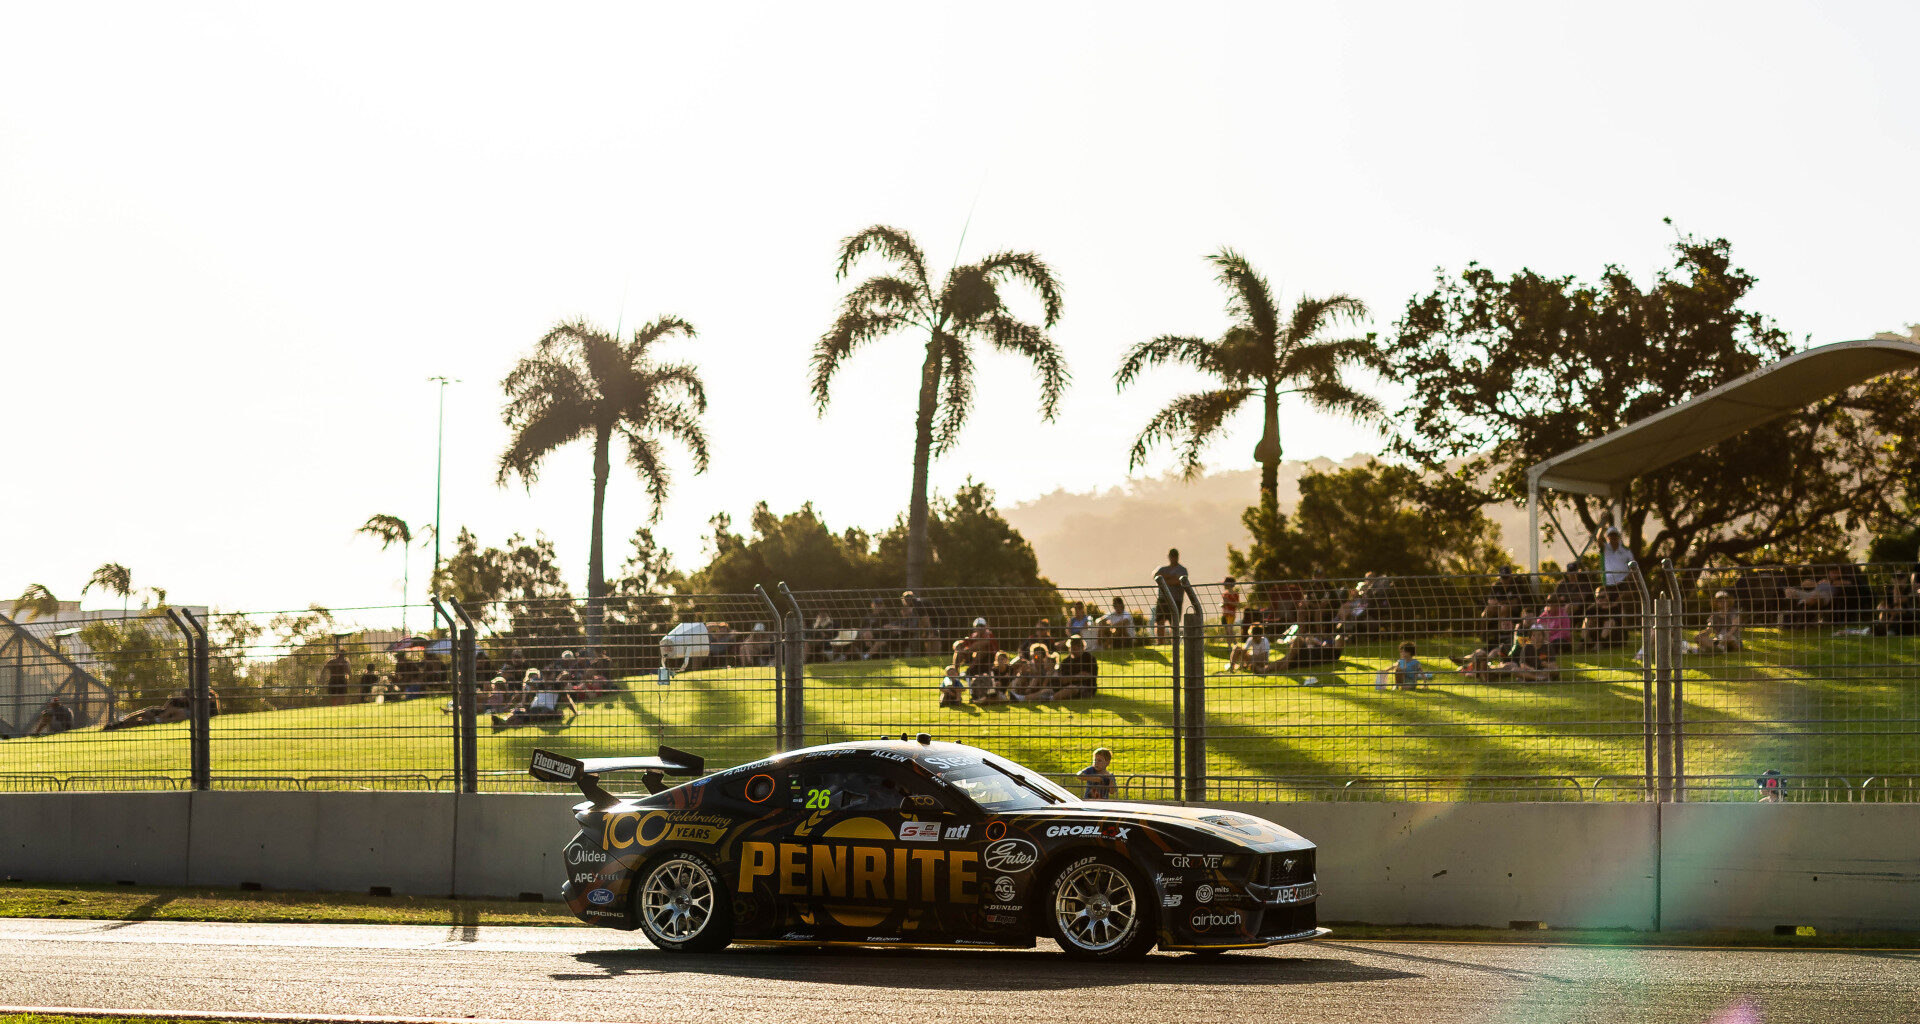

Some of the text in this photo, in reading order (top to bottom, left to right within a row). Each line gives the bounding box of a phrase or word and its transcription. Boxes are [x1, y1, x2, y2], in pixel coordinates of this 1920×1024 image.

[533, 752, 577, 778] Floorway
[871, 750, 908, 763] ALLEN
[806, 788, 831, 809] 26
[666, 810, 734, 828] Celebrating
[602, 811, 671, 850] 100
[676, 827, 711, 840] YEARS
[944, 824, 971, 839] nti
[568, 843, 606, 865] Midea
[986, 842, 1037, 868] Gates
[680, 852, 718, 884] DUNLOP
[738, 841, 979, 904] PENRITE
[1054, 856, 1097, 889] DUNLOP
[574, 872, 598, 883] APEX
[591, 890, 609, 903] Ford
[995, 884, 1016, 894] ACL
[1214, 885, 1230, 893] mits
[1276, 886, 1299, 904] APEX
[586, 910, 624, 918] RACING
[1192, 911, 1242, 926] airtouch
